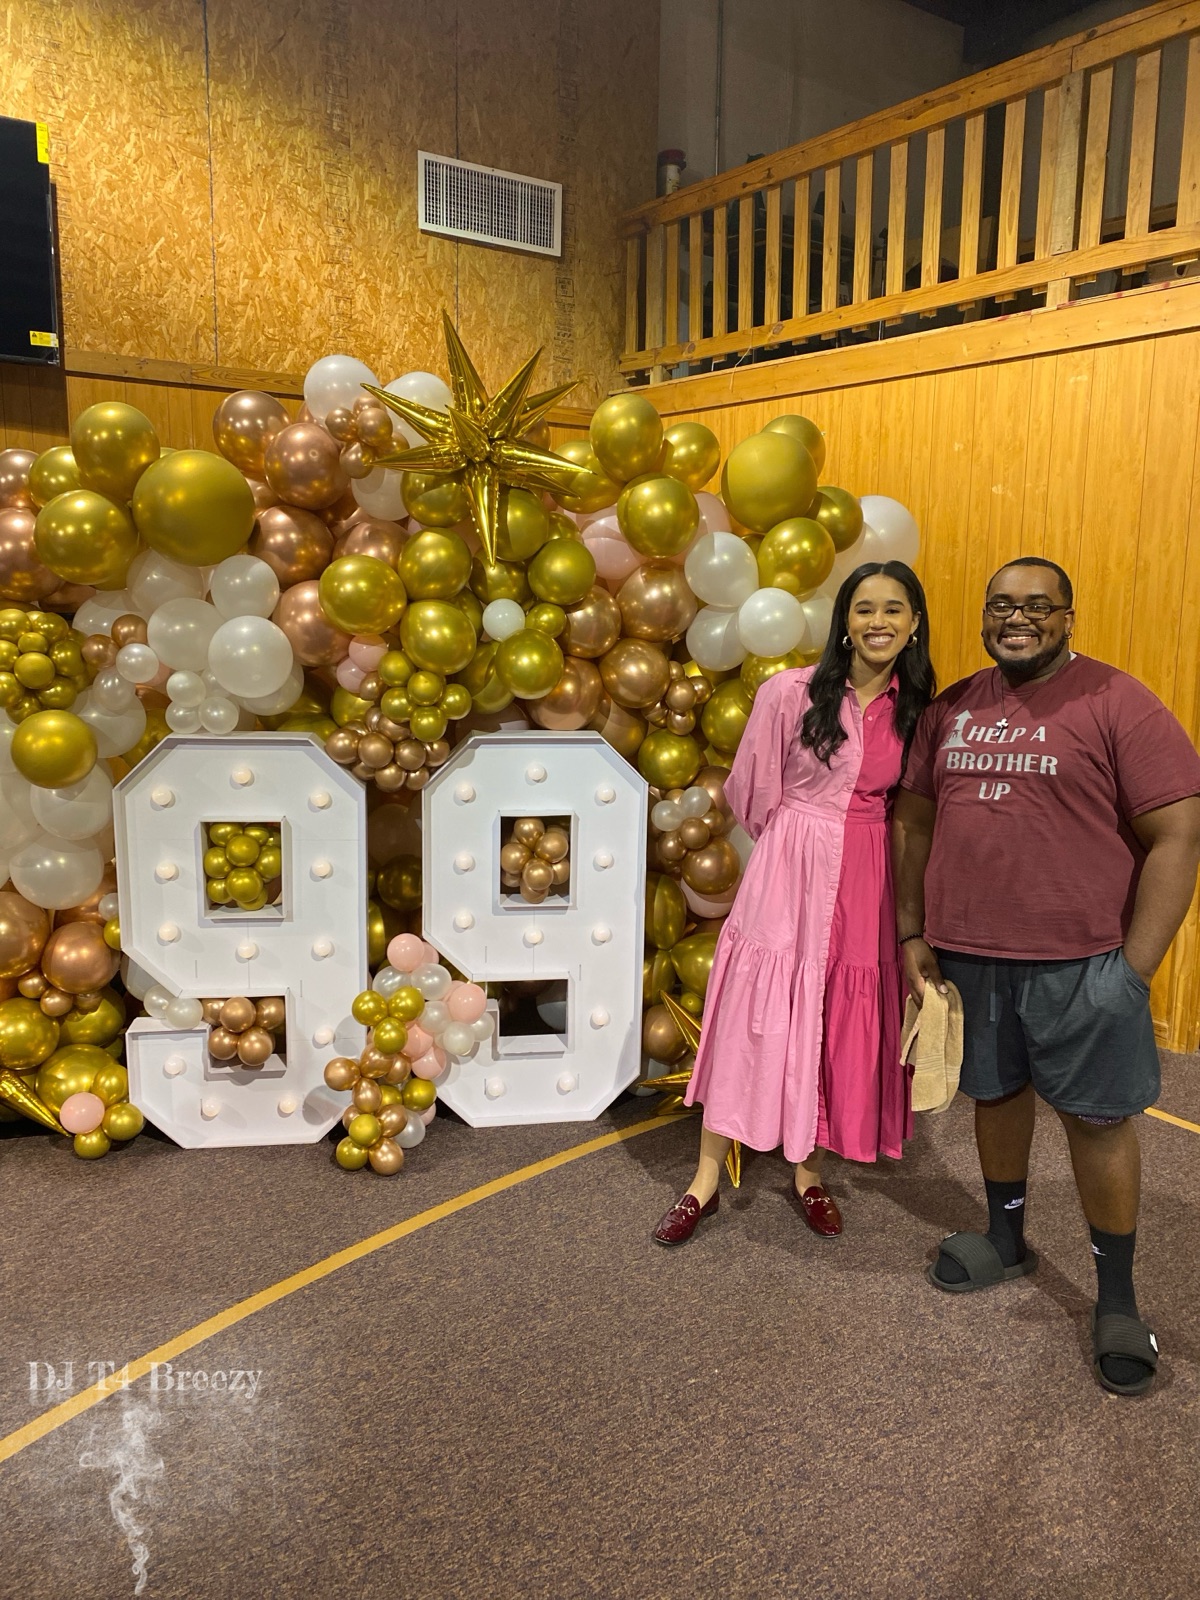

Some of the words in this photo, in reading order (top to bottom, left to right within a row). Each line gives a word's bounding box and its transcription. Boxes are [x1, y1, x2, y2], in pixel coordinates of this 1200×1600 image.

[966, 725, 1027, 744] HELP
[1030, 725, 1046, 742] A
[946, 751, 1058, 775] BROTHER
[978, 782, 1011, 800] UP
